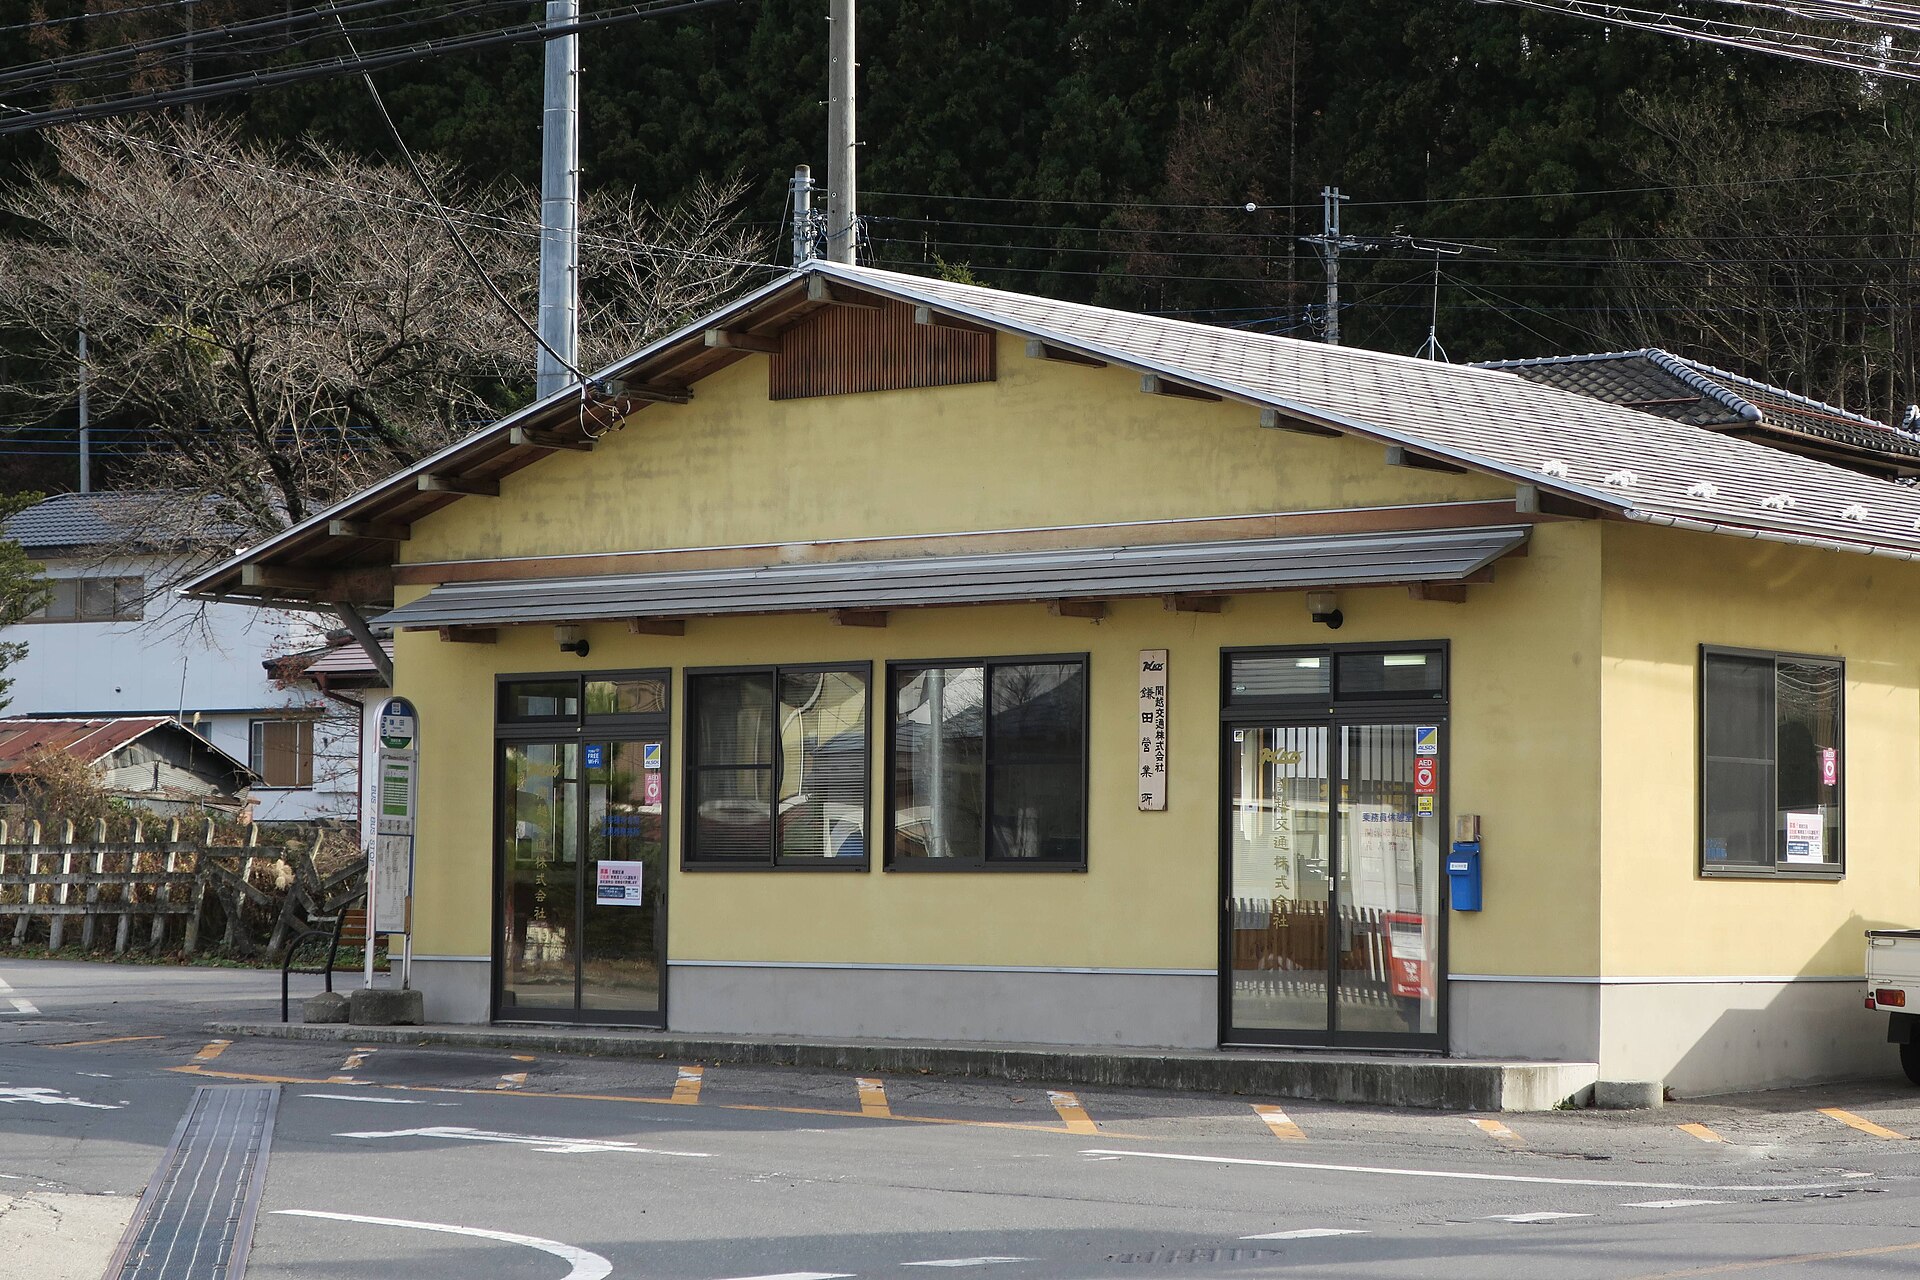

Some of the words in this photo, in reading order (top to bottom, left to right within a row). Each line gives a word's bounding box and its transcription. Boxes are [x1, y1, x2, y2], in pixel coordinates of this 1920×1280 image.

[1155, 685, 1165, 773] 関越交通株式会社
